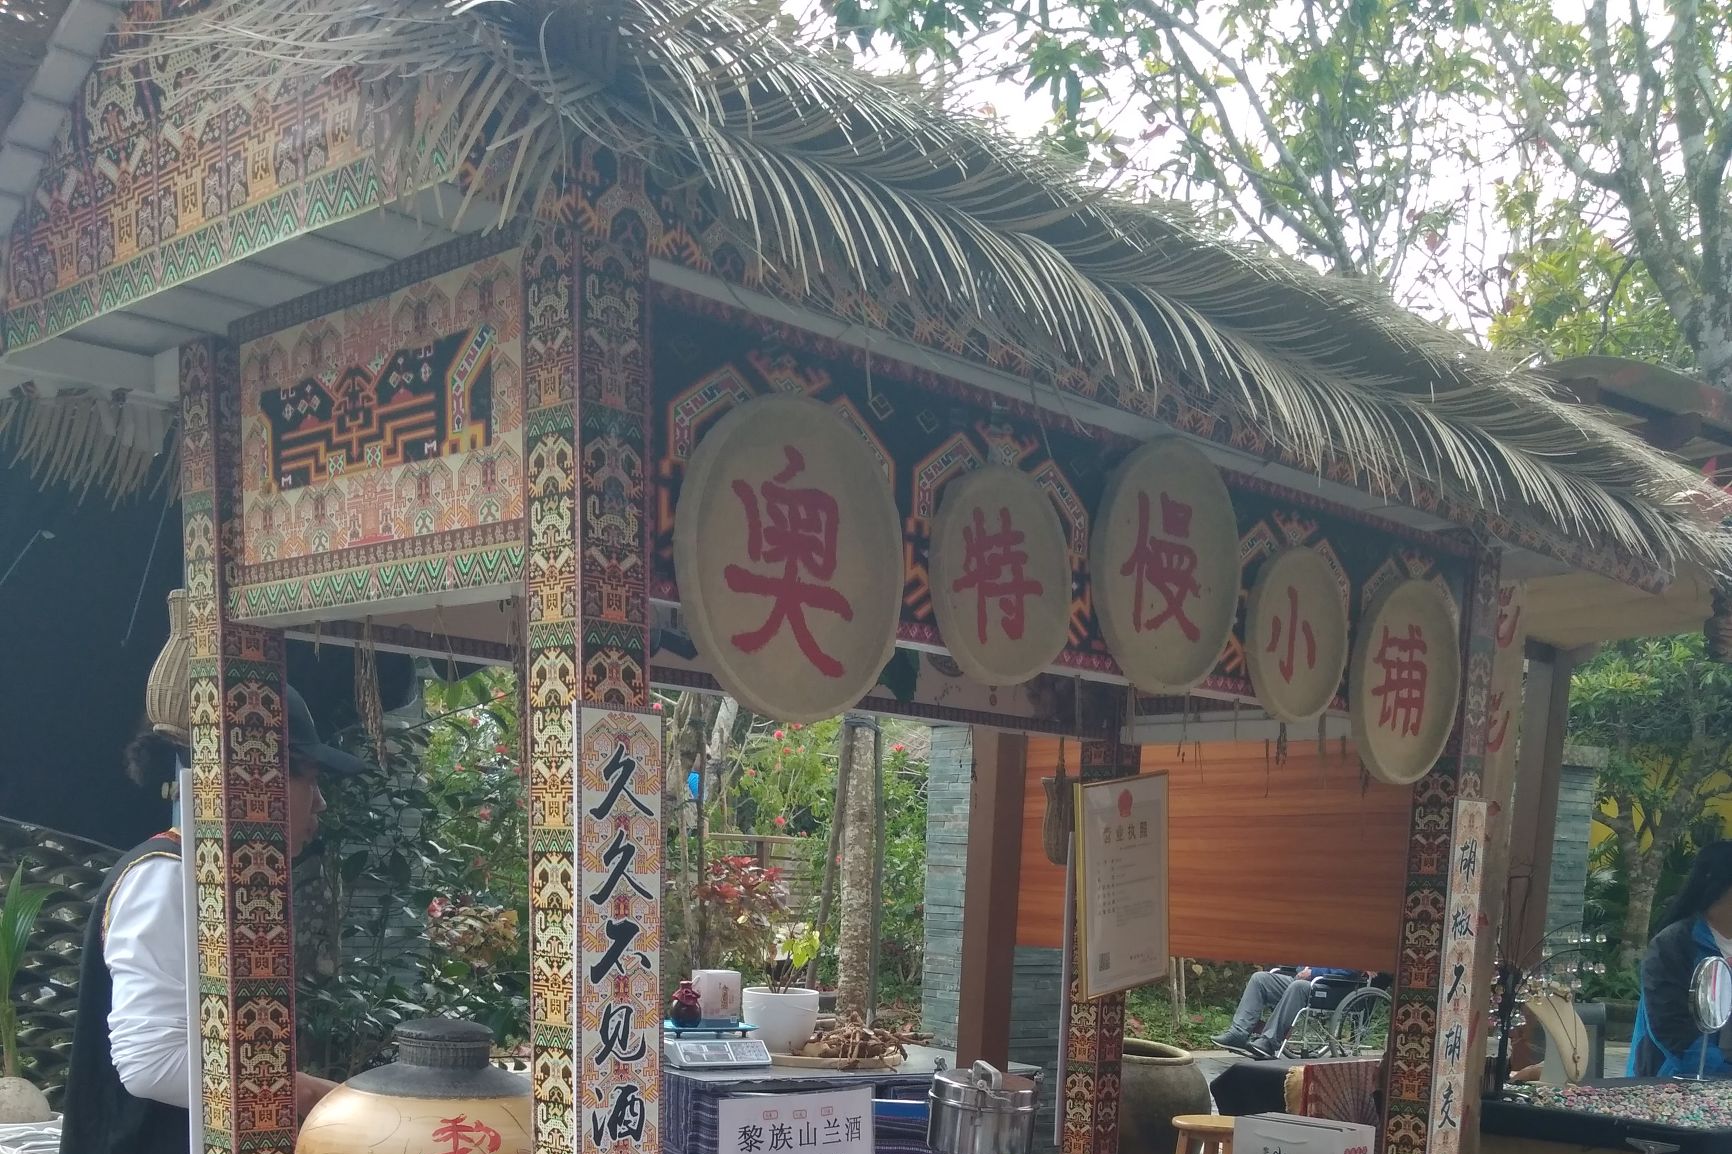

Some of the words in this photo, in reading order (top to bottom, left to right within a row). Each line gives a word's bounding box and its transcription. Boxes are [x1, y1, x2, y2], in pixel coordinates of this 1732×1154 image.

[737, 1115, 861, 1153] 黎族山兰酒
